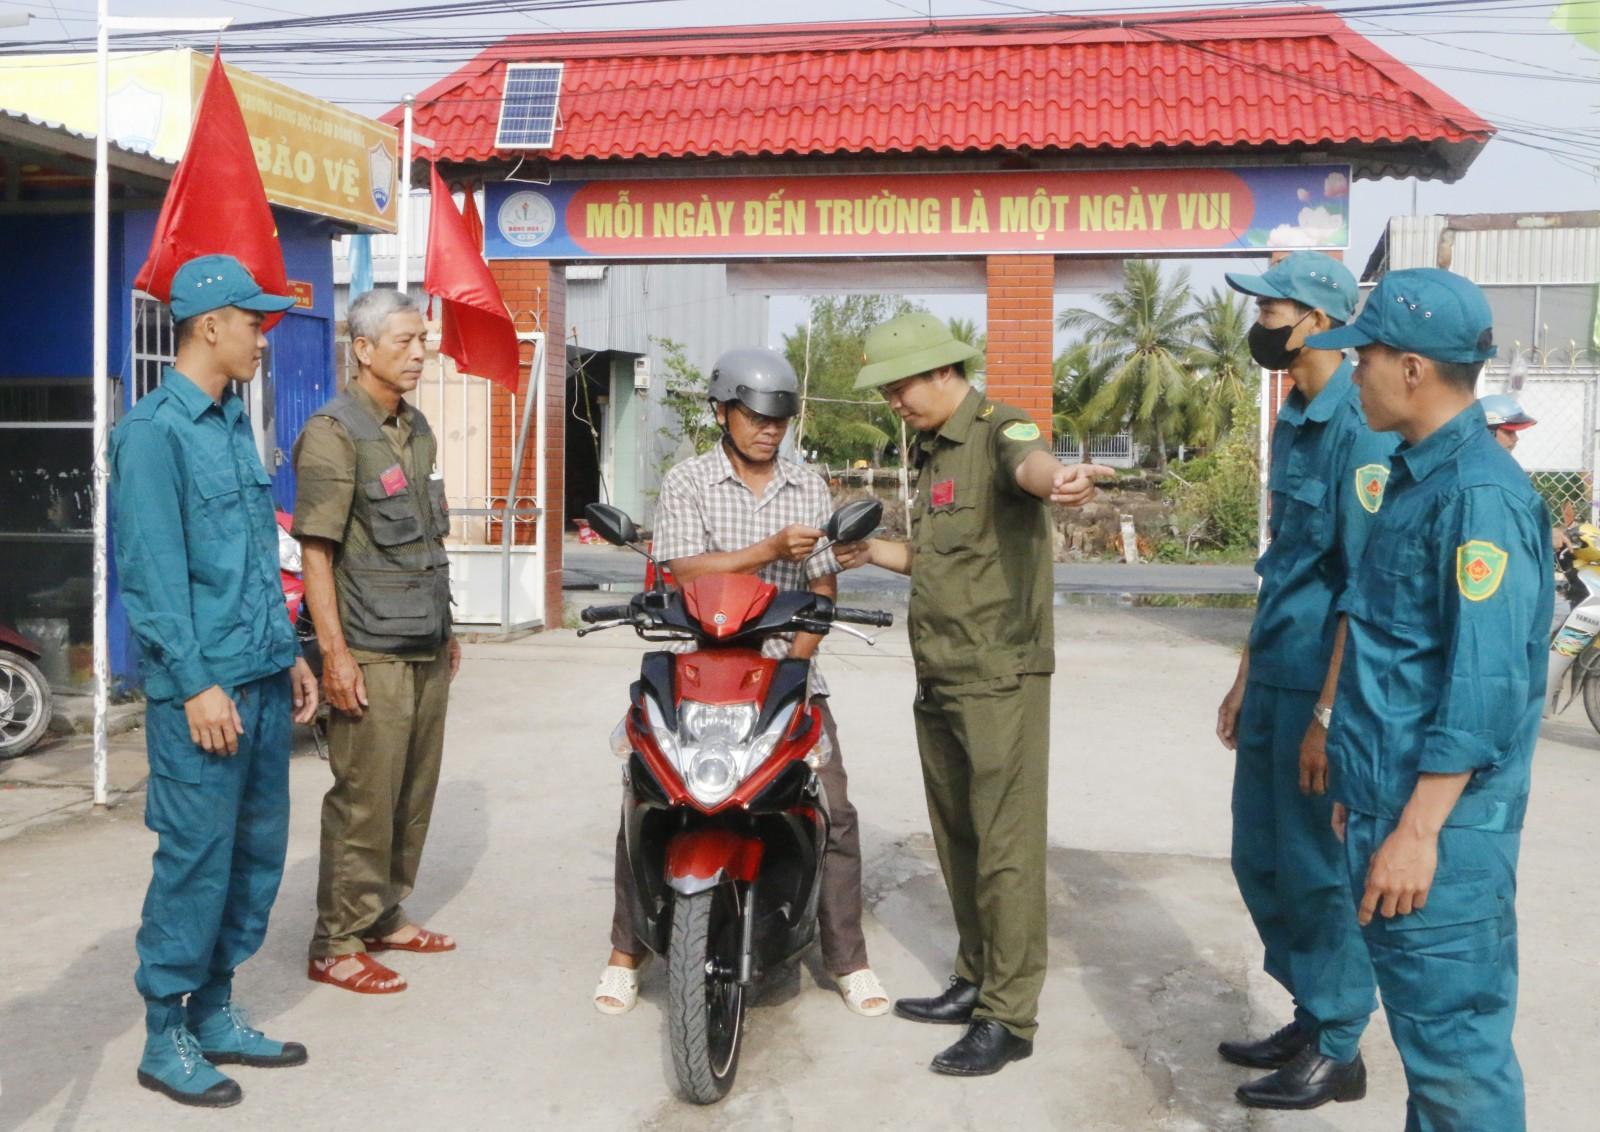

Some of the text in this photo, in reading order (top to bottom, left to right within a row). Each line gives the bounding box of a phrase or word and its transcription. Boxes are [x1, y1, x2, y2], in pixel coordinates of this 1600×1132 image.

[249, 135, 360, 203] BẢO VỆ
[586, 187, 1231, 240] MỖI NGÀY ĐẾN TRƯỜNG LÀ MỘT NGÀY VUI
